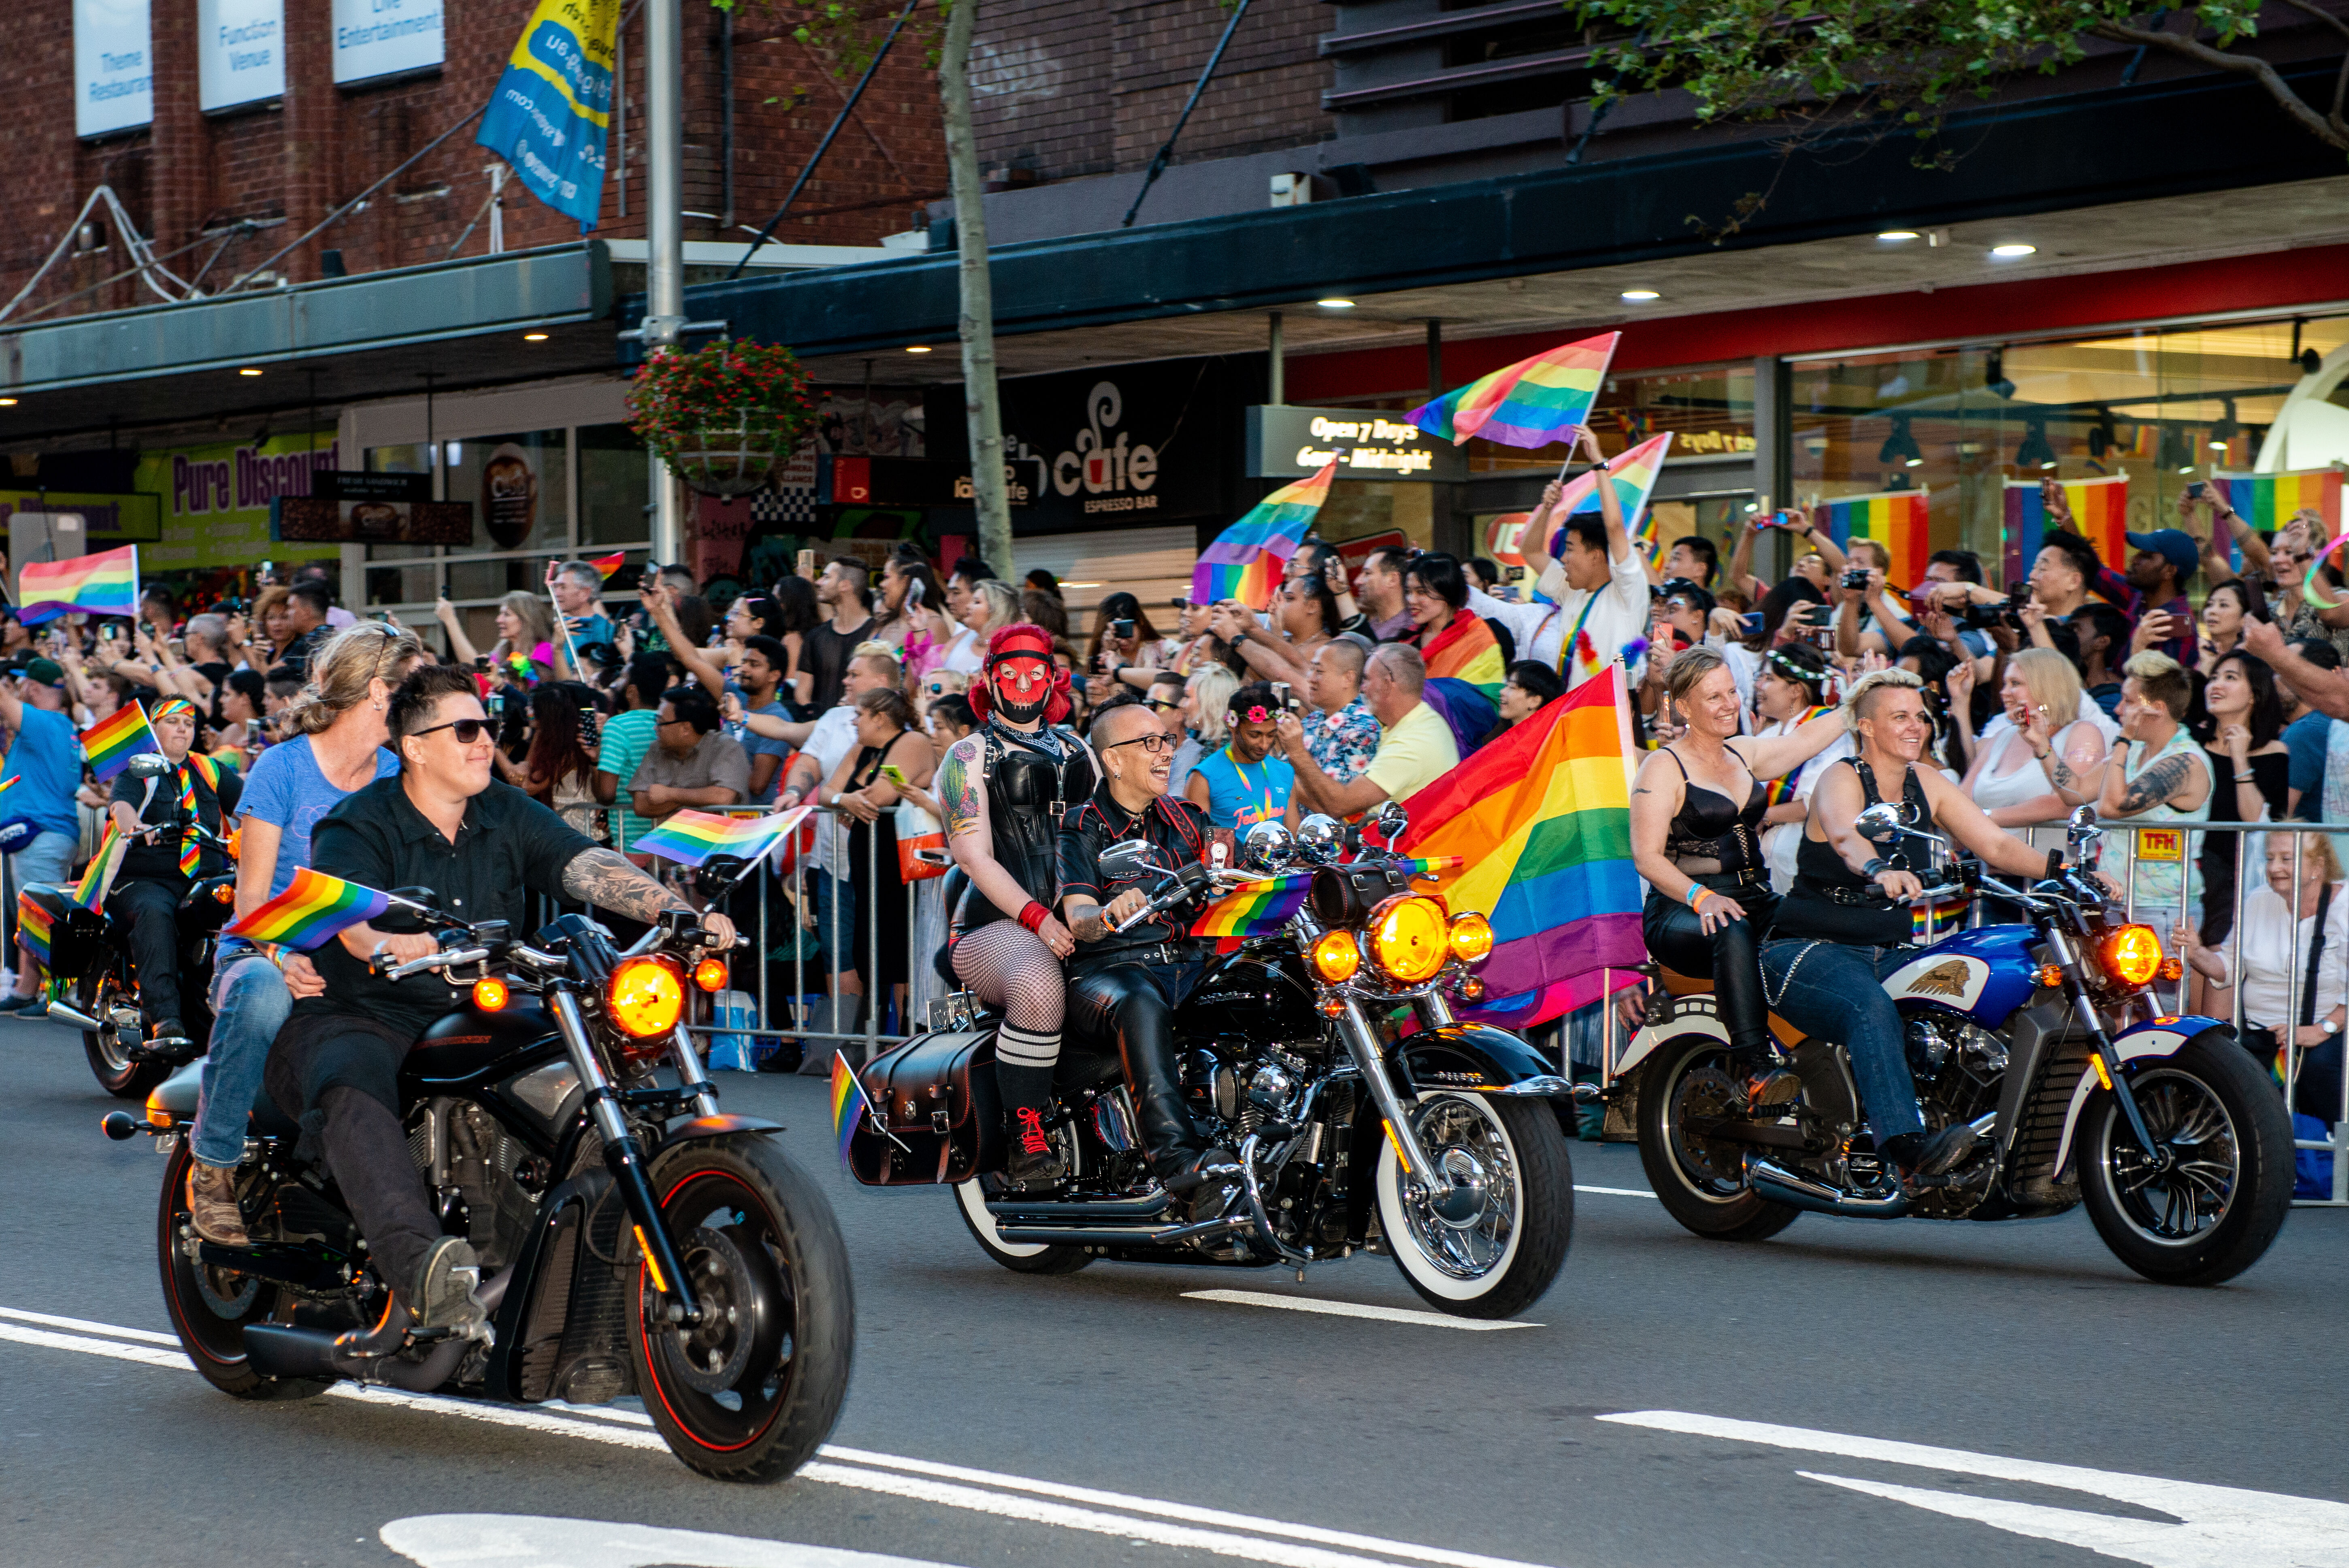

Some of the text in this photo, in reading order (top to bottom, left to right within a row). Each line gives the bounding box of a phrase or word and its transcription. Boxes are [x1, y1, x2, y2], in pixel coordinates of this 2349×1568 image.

[219, 19, 277, 47] Function
[339, 9, 441, 49] Entertainment
[101, 51, 142, 73] Theme
[230, 49, 270, 71] Venue
[89, 76, 152, 103] Restauran
[1310, 417, 1419, 445] Open 7 Days
[1053, 427, 1158, 496] cafe
[1350, 447, 1433, 475] Midnight
[173, 446, 229, 514] Pure
[1084, 495, 1158, 513] ESPRESSO BAR
[2144, 833, 2174, 849] TFH
